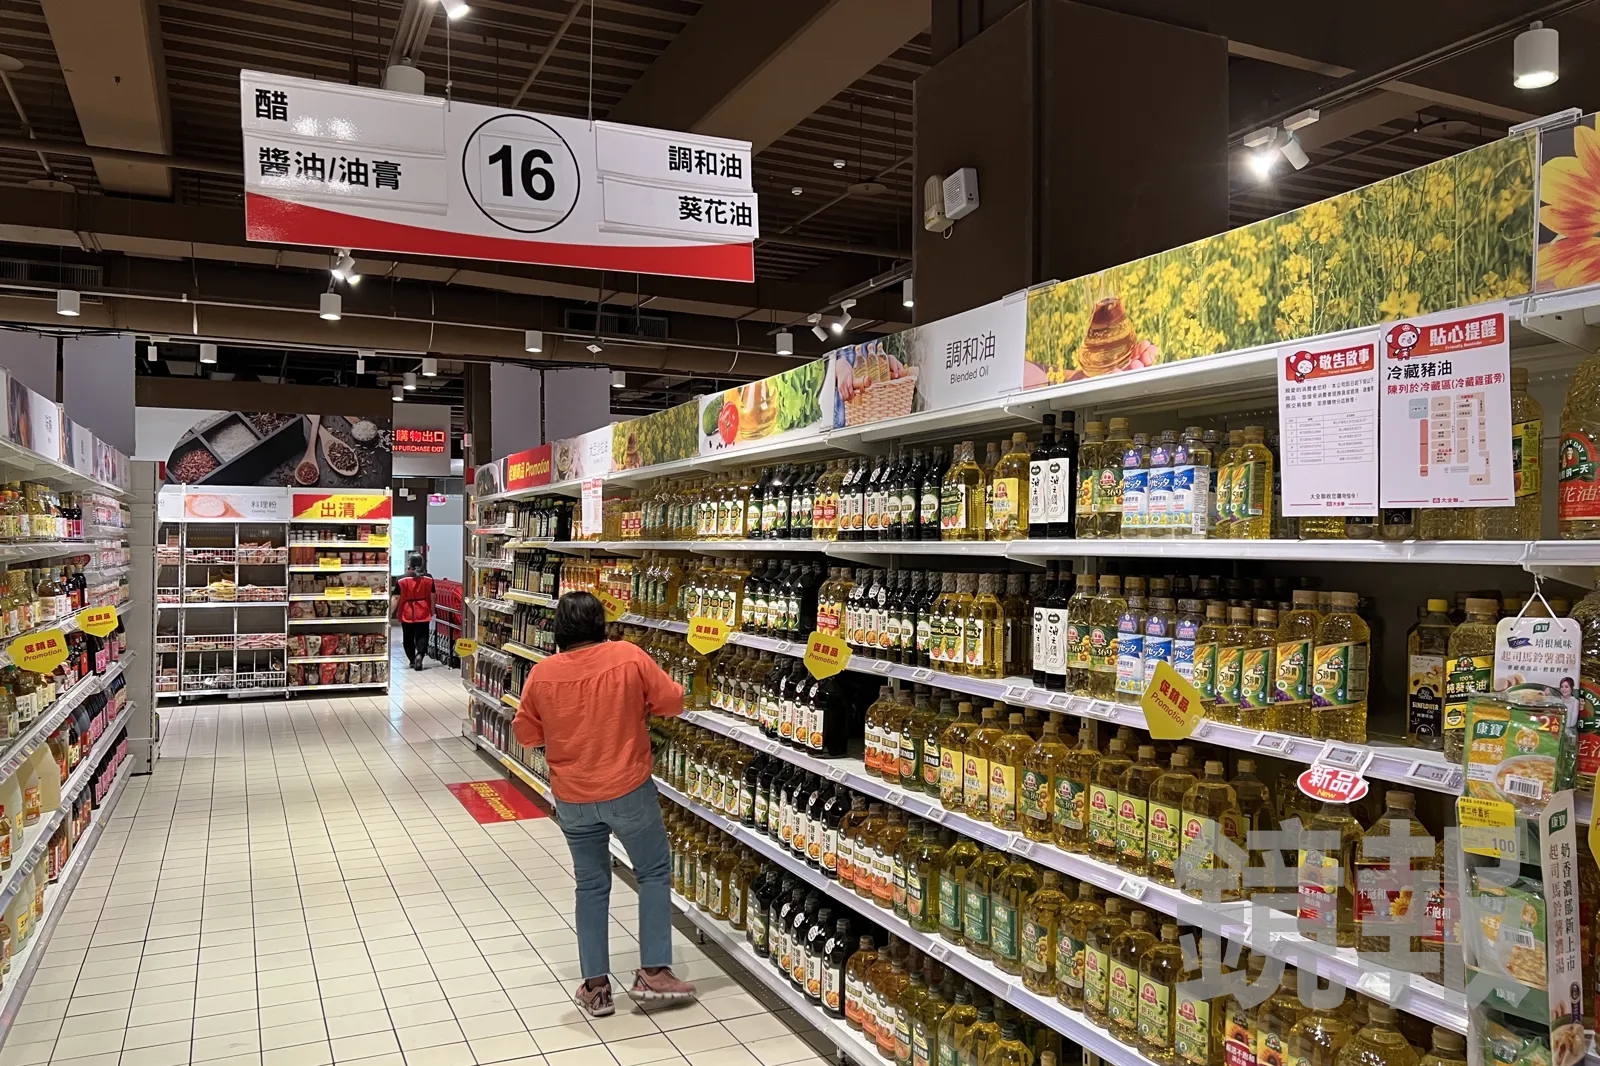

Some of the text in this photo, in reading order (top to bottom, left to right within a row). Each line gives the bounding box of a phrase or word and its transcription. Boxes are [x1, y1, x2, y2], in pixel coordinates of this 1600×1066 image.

[254, 88, 289, 121] 醋
[258, 146, 401, 191] 醬油/油膏
[668, 145, 743, 180] 調和油
[487, 143, 556, 202] 16
[677, 196, 753, 228] 葵花油
[1429, 318, 1497, 347] 貼心提醒
[945, 330, 996, 370] 調和油
[950, 365, 989, 385] Blended Oil
[1387, 360, 1452, 381] 冷藏豬油
[1387, 372, 1505, 396] 陳列於冷藏區(冷藏雞蛋旁)
[1573, 440, 1585, 453] DAY
[525, 458, 550, 478] Promotion
[251, 500, 277, 510] 料理粉
[320, 501, 356, 518] 出清
[86, 620, 114, 628] Promotion
[87, 612, 111, 622] 促銷品
[692, 632, 721, 643] Promotion
[695, 624, 719, 636] 促銷品
[24, 638, 57, 654] 促銷品
[813, 642, 839, 658] 促銷品
[1535, 638, 1573, 649] 培根風味
[23, 648, 62, 662] Promotion
[808, 652, 839, 667] Promotion
[1096, 648, 1113, 656] 369
[1500, 650, 1576, 666] 起司馬鈴薯濃湯
[1316, 669, 1336, 681] 5珍寶
[1159, 678, 1190, 714] 促銷品
[1150, 691, 1186, 728] Promotion
[1412, 701, 1439, 711] SUNFLOWER
[1476, 722, 1503, 737] 康寶
[1538, 715, 1560, 733] 2 人份
[1317, 788, 1337, 800] New
[1550, 814, 1567, 829] 康寶
[1491, 837, 1516, 853] 100
[1424, 906, 1451, 919] 不飽和
[1548, 843, 1566, 975] 起司馬鈴薯濃湯
[1560, 842, 1576, 972] 奶香濃郁新上市
